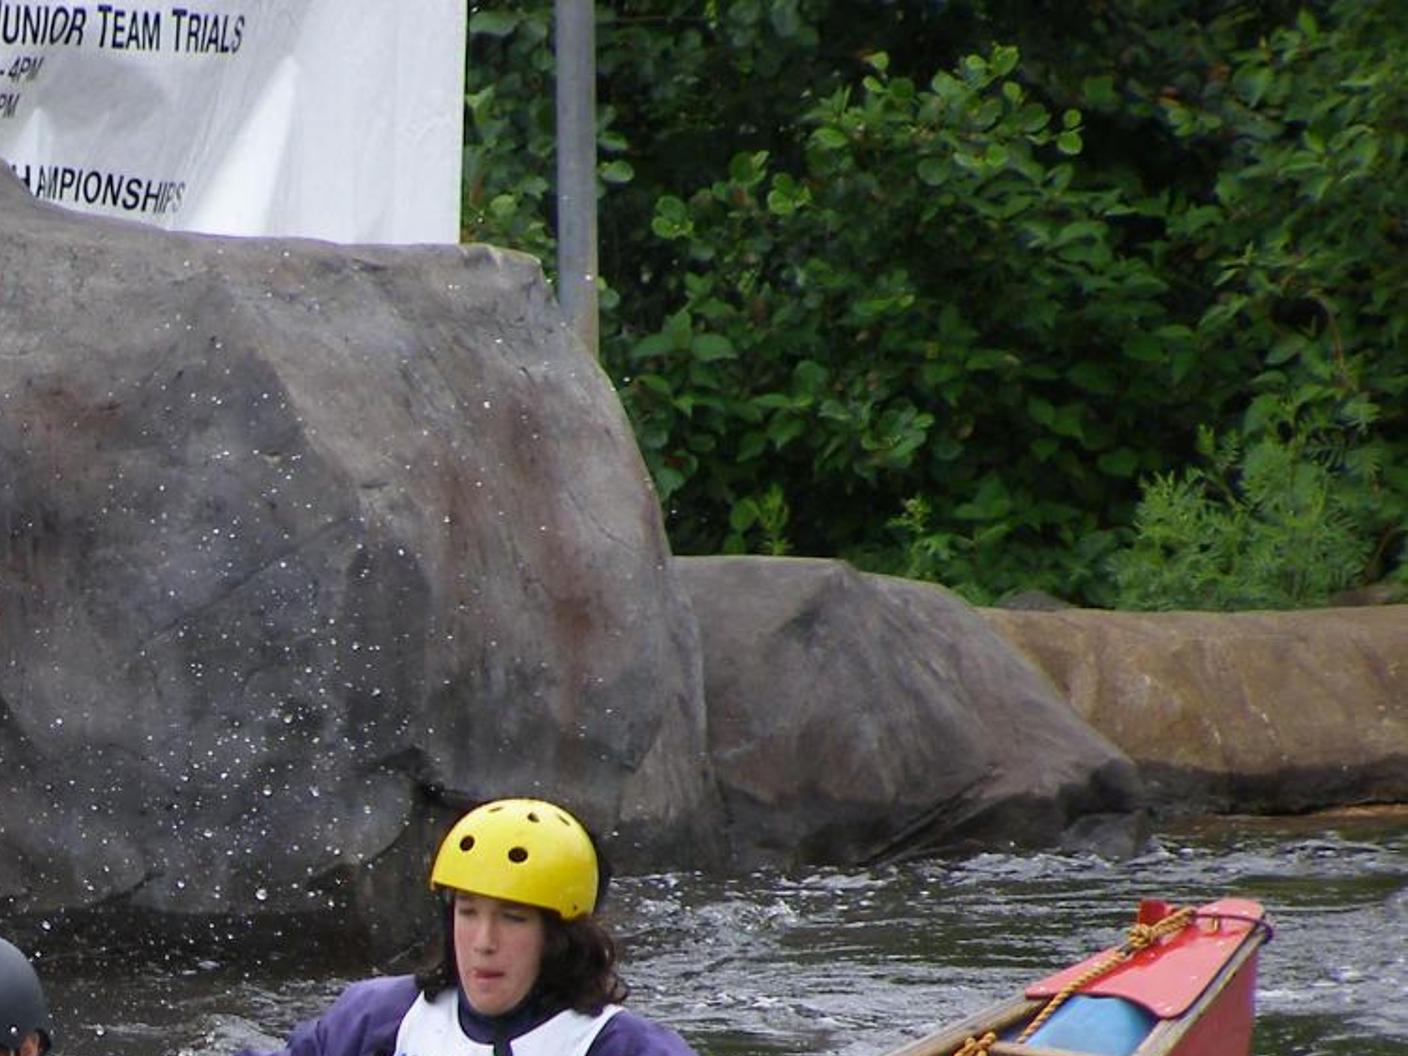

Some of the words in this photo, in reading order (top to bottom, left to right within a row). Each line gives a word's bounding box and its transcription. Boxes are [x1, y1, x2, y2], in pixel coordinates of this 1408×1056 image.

[97, 4, 161, 51] TEAM
[172, 8, 245, 54] TRIALS
[8, 55, 44, 83] 4PM
[12, 164, 186, 214] AMPIONSHIPS
